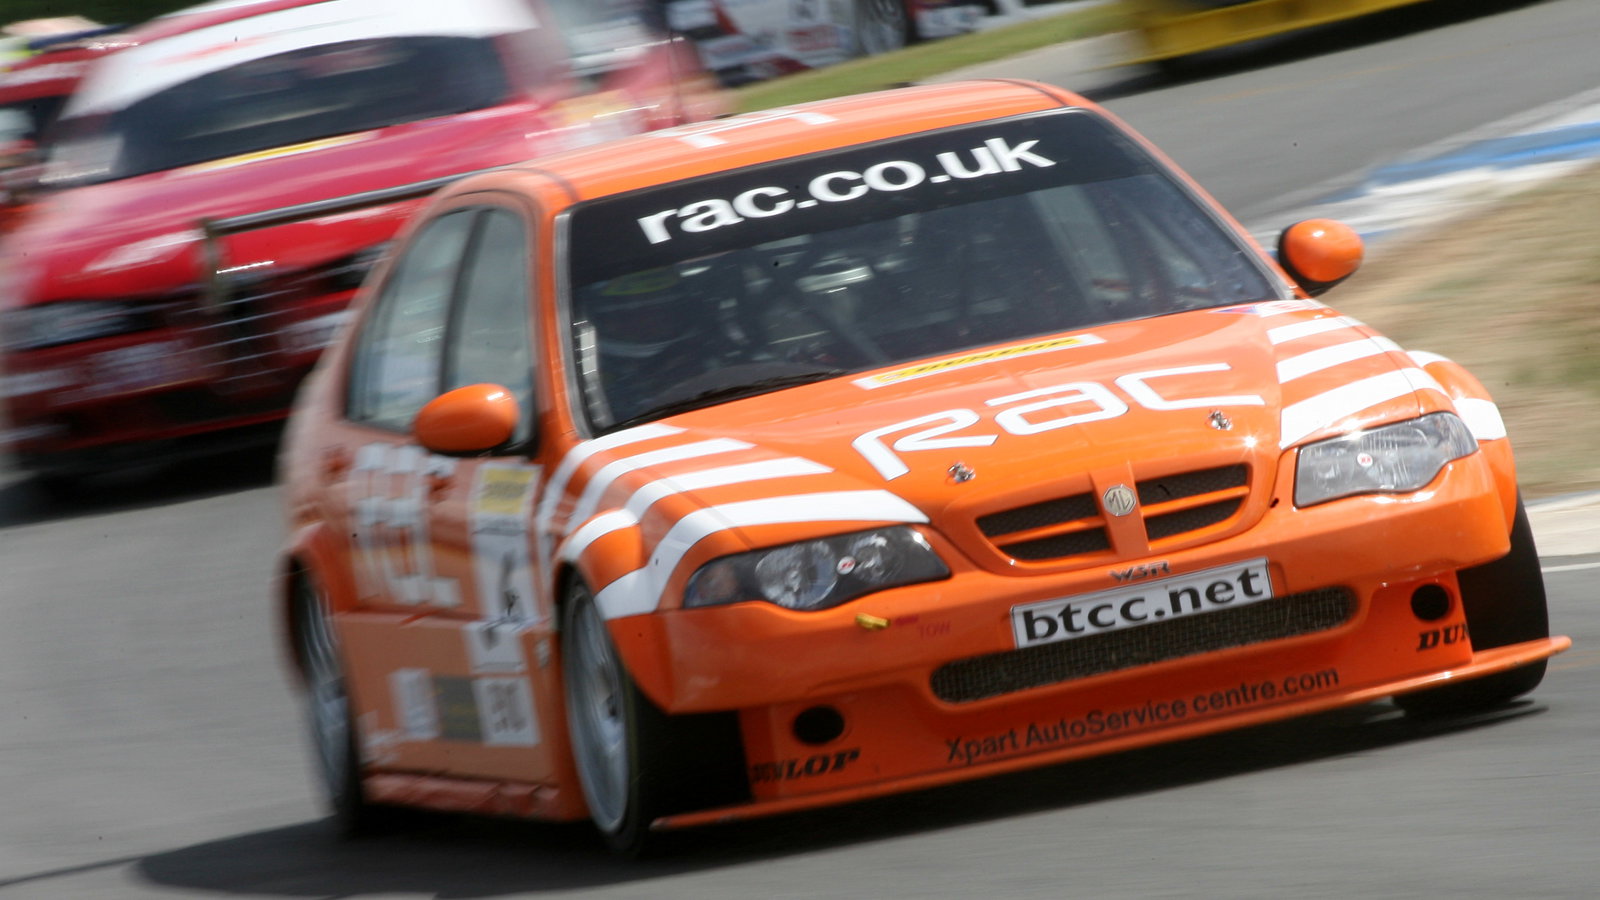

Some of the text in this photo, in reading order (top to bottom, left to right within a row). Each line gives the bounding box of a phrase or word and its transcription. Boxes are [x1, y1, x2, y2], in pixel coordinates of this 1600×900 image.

[638, 138, 1056, 244] rac.co.uk
[1023, 568, 1263, 640] btcc.net
[946, 668, 1340, 766] Xpart AutoService centre.com
